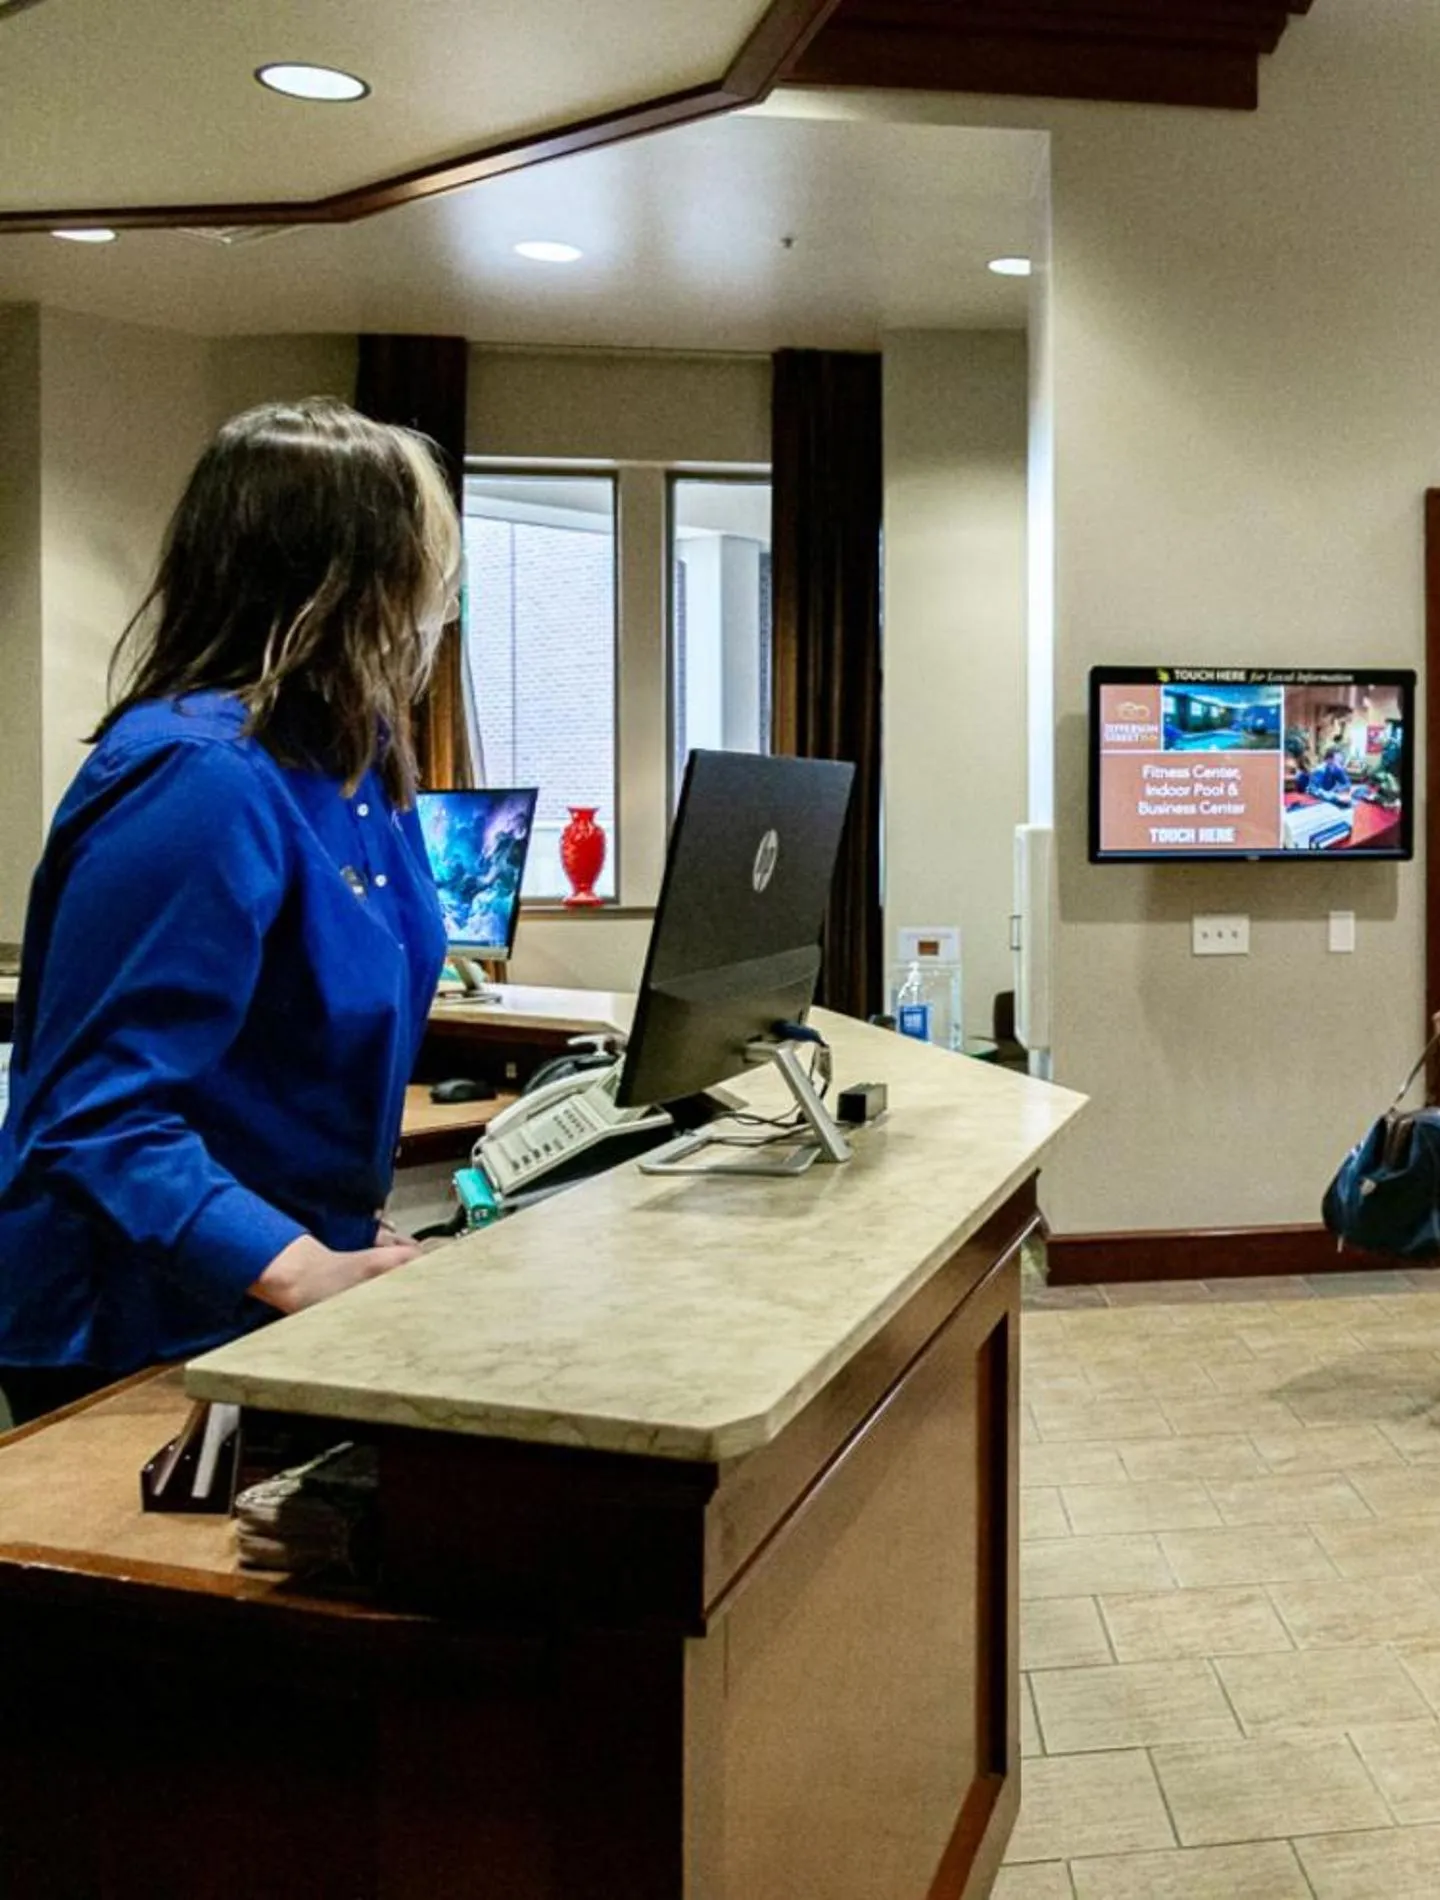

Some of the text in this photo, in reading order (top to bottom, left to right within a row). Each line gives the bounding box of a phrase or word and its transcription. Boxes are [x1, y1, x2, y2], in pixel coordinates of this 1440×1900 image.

[1174, 669, 1214, 681] TOUCH
[1216, 670, 1246, 681] HERE
[1143, 764, 1190, 779] Fitness
[1145, 782, 1191, 797] Indoor
[1193, 782, 1225, 797] Pool
[1137, 800, 1246, 815] Business Center
[1149, 827, 1196, 843] TOUCH
